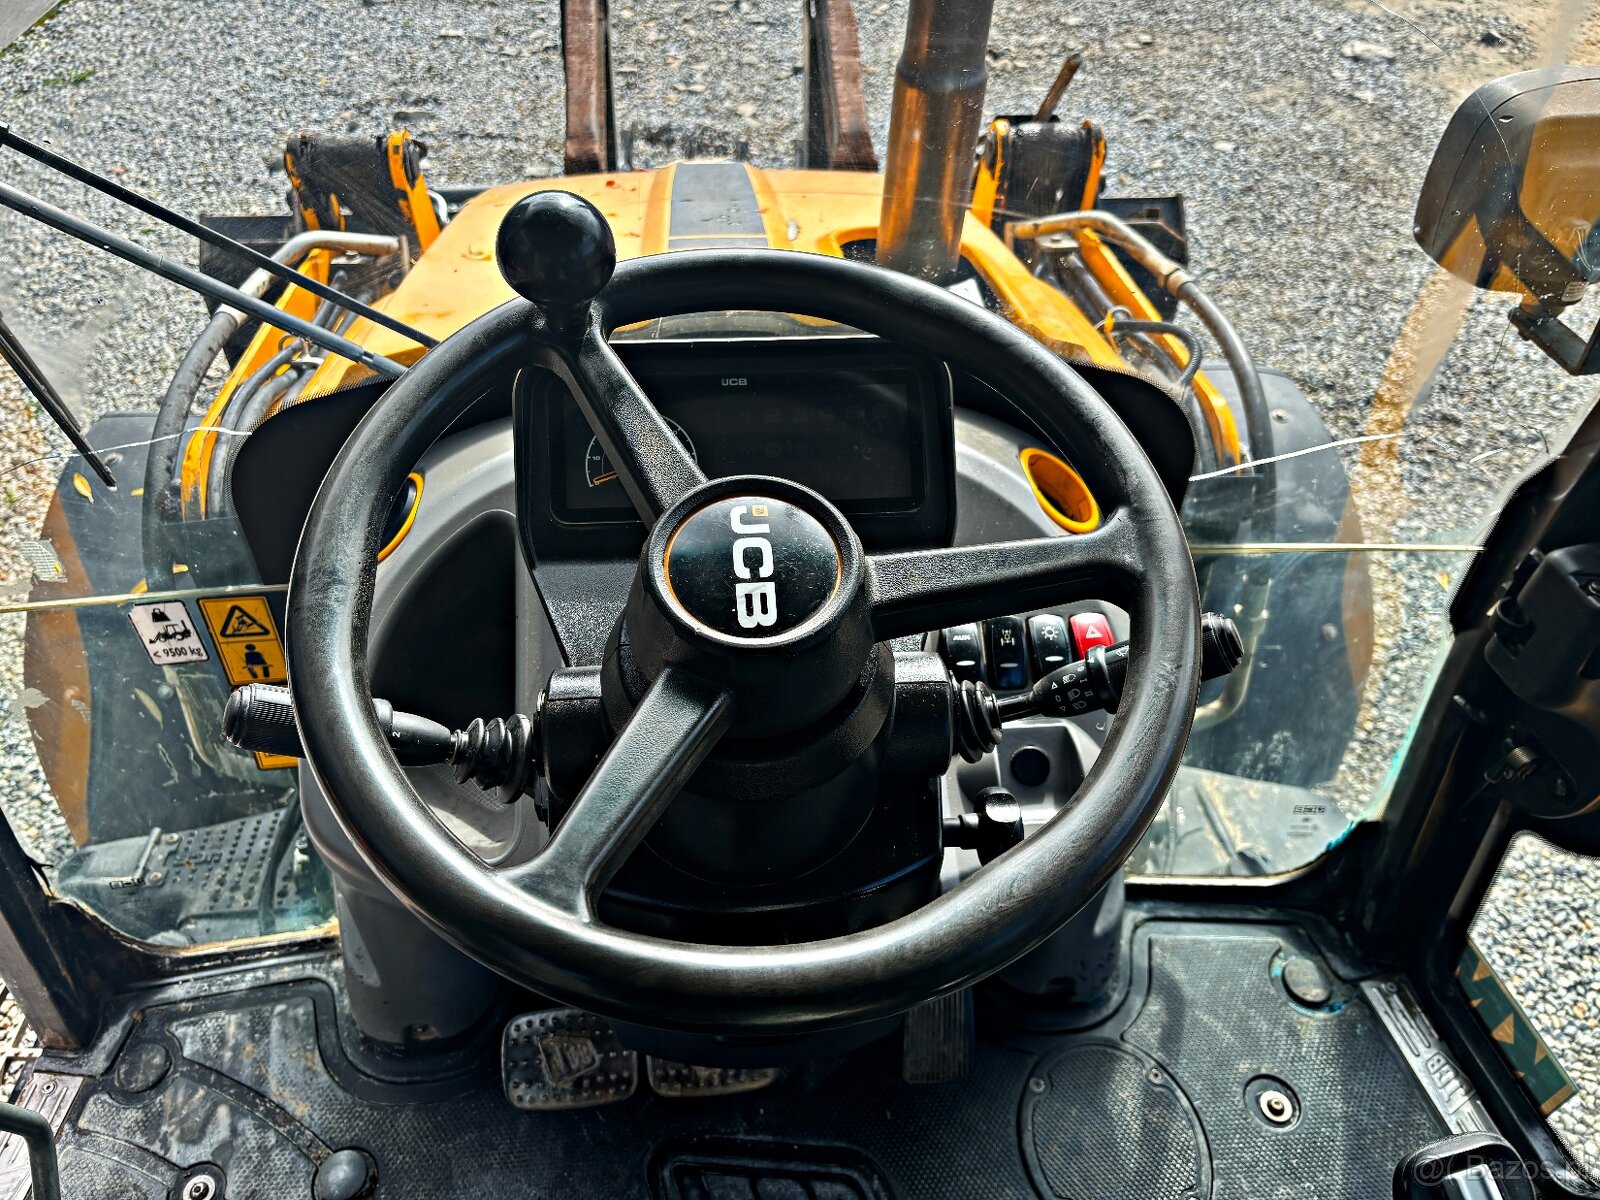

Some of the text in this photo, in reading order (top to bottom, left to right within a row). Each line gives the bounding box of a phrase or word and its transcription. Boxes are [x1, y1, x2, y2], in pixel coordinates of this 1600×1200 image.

[720, 378, 748, 386] JCB
[730, 504, 778, 629] JCB
[162, 646, 188, 658] 9500
[188, 646, 204, 657] kg
